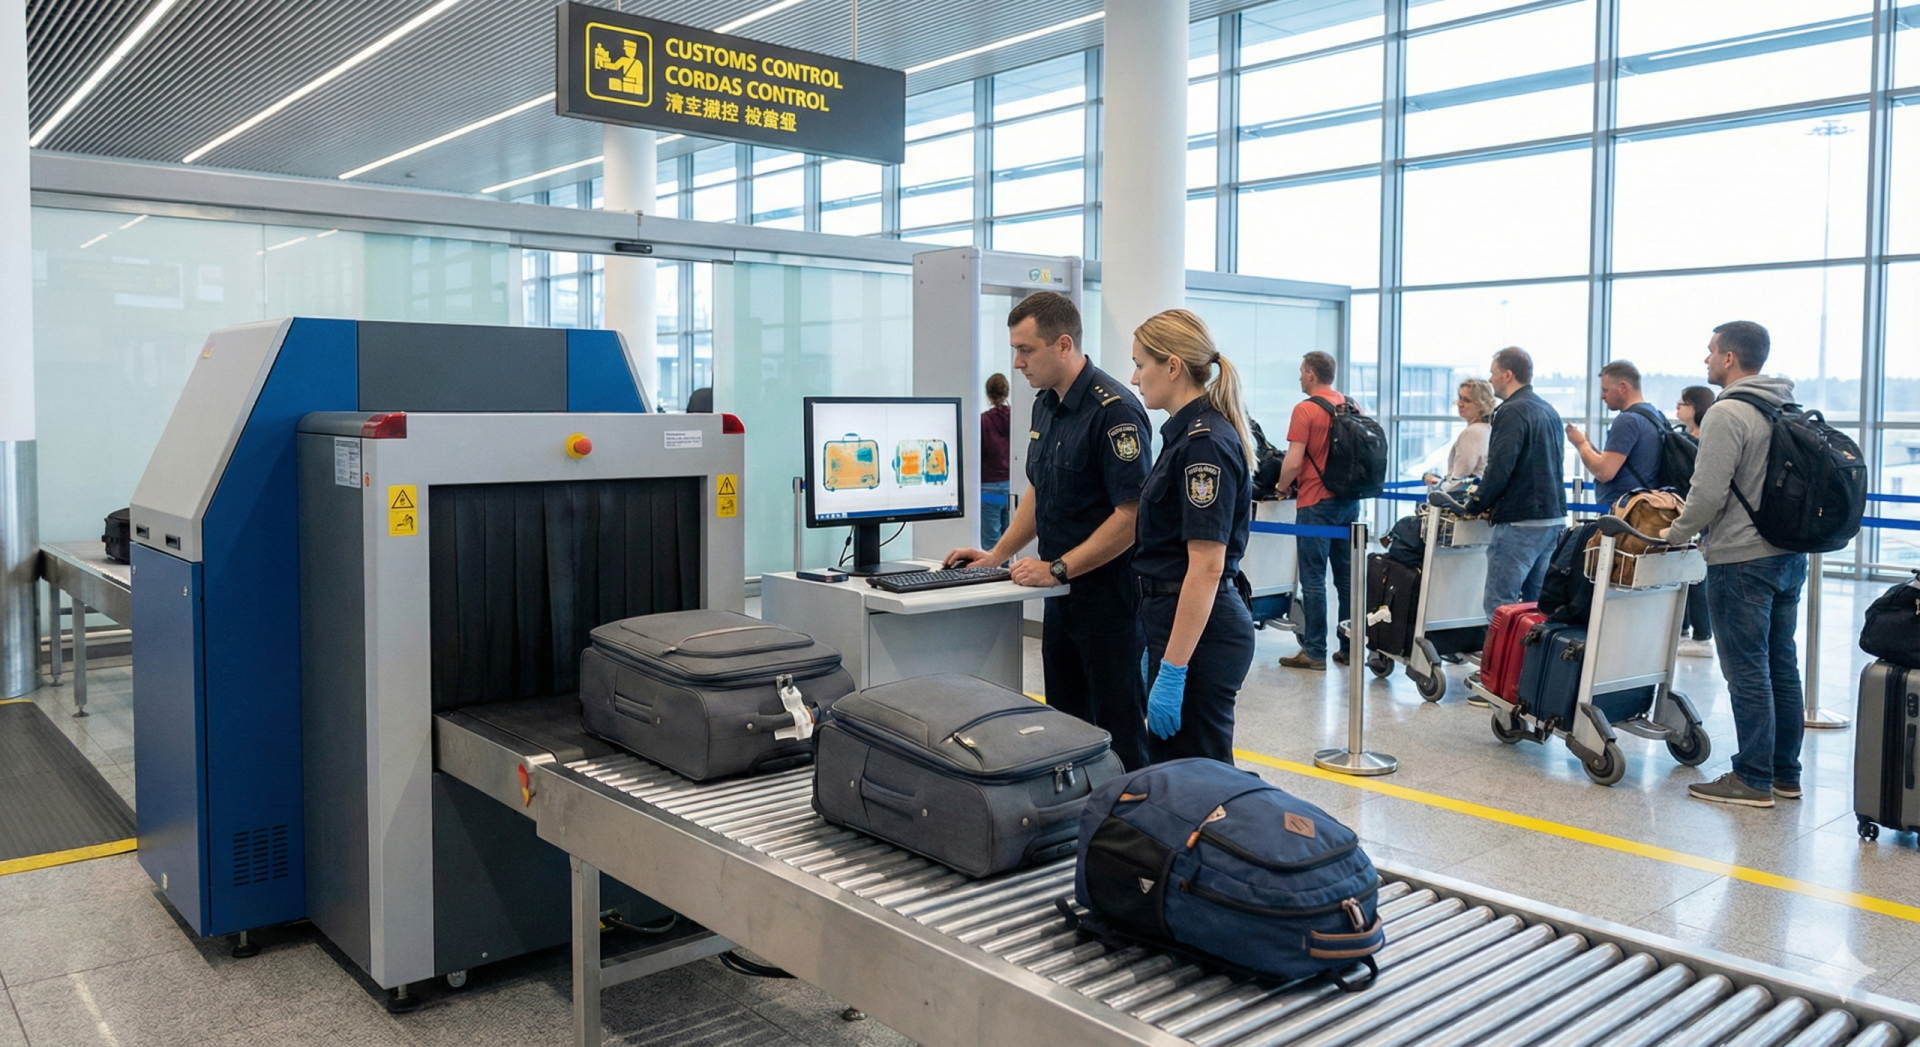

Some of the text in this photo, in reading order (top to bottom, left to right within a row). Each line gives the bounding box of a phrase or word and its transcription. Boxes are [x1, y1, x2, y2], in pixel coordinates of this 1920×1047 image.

[664, 37, 844, 90] CUSTOMS CONTROL
[664, 65, 830, 112] CORDAS CONTROL
